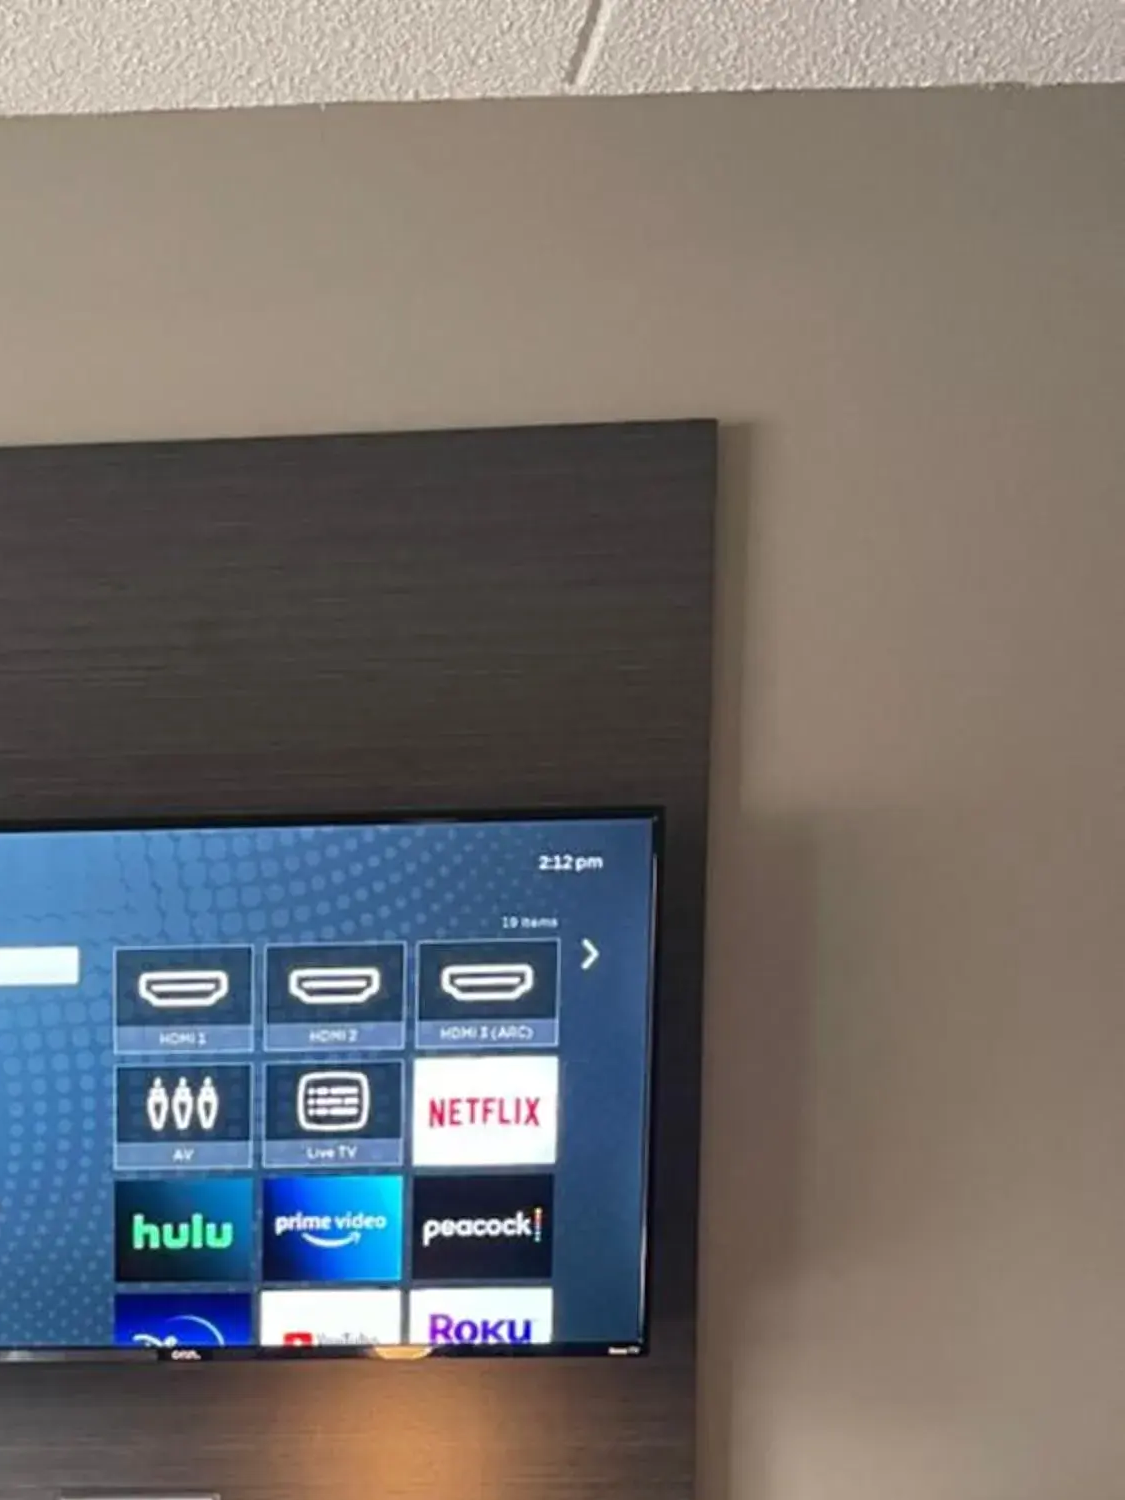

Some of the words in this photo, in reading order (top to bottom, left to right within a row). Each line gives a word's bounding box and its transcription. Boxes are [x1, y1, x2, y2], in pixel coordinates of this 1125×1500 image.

[538, 854, 573, 870] 2:12
[575, 856, 604, 873] pm
[159, 1032, 195, 1045] HDMI
[309, 1029, 346, 1043] HDMI
[348, 1029, 358, 1042] 2
[439, 1026, 477, 1040] HDMI
[490, 1024, 535, 1041] (ARC)
[429, 1097, 541, 1128] NETFLIX
[172, 1148, 194, 1162] AV
[306, 1147, 335, 1159] Live
[338, 1145, 358, 1159] TV
[132, 1213, 233, 1250] hulu
[275, 1212, 332, 1234] prime
[335, 1210, 386, 1230] video
[422, 1210, 533, 1247] peacock
[428, 1312, 532, 1346] Roku
